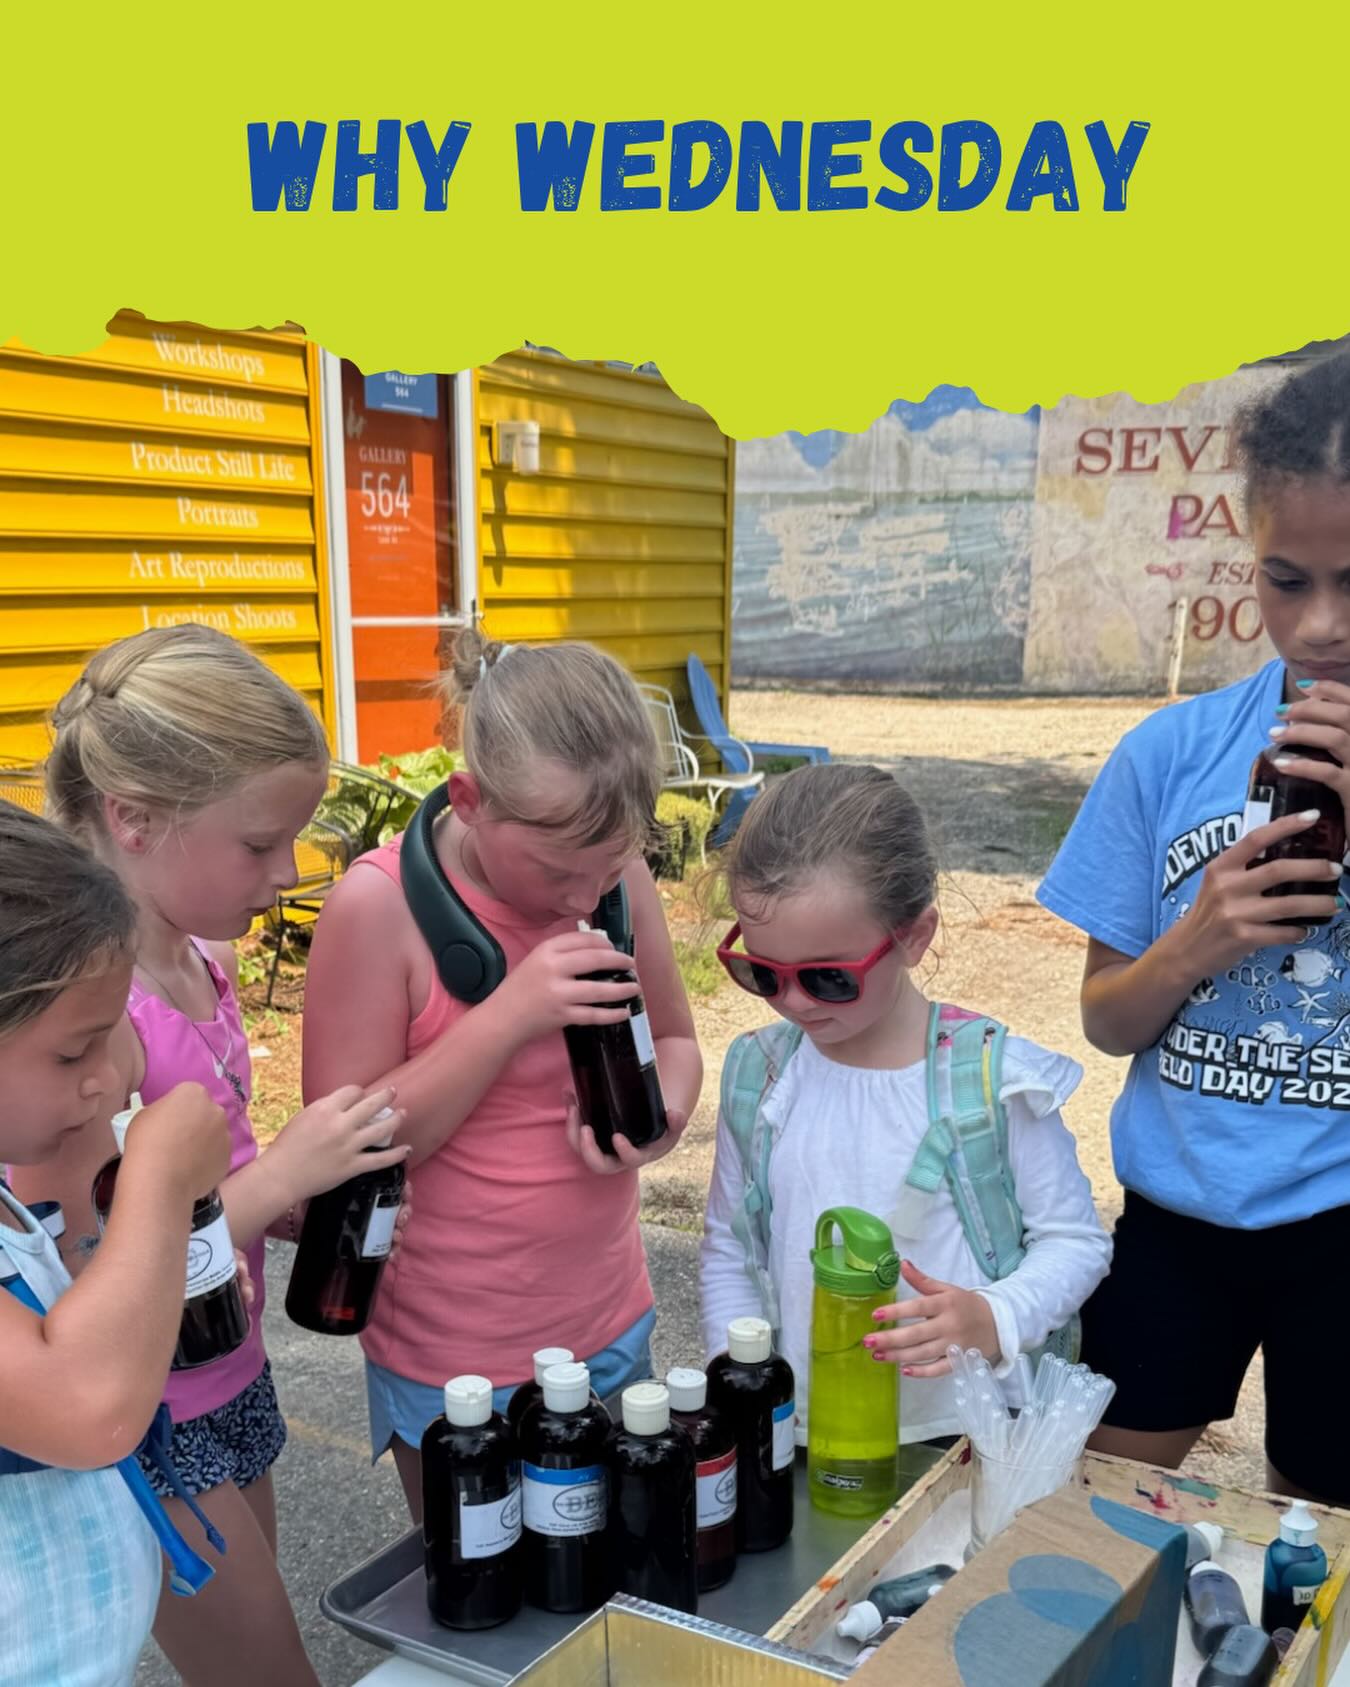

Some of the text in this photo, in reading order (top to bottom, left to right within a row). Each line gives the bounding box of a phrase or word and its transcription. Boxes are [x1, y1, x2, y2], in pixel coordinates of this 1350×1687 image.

[152, 332, 265, 382] Workshops
[161, 384, 265, 423] Headshots
[130, 442, 295, 481] Product Still Life
[359, 446, 407, 464] GALLERY
[177, 497, 259, 527] Portraits
[361, 471, 411, 518] 564
[129, 551, 304, 588] Art Reproductions
[233, 602, 297, 630] Shoots
[1236, 1035, 1300, 1072] THE
[1201, 1064, 1275, 1099] DAY
